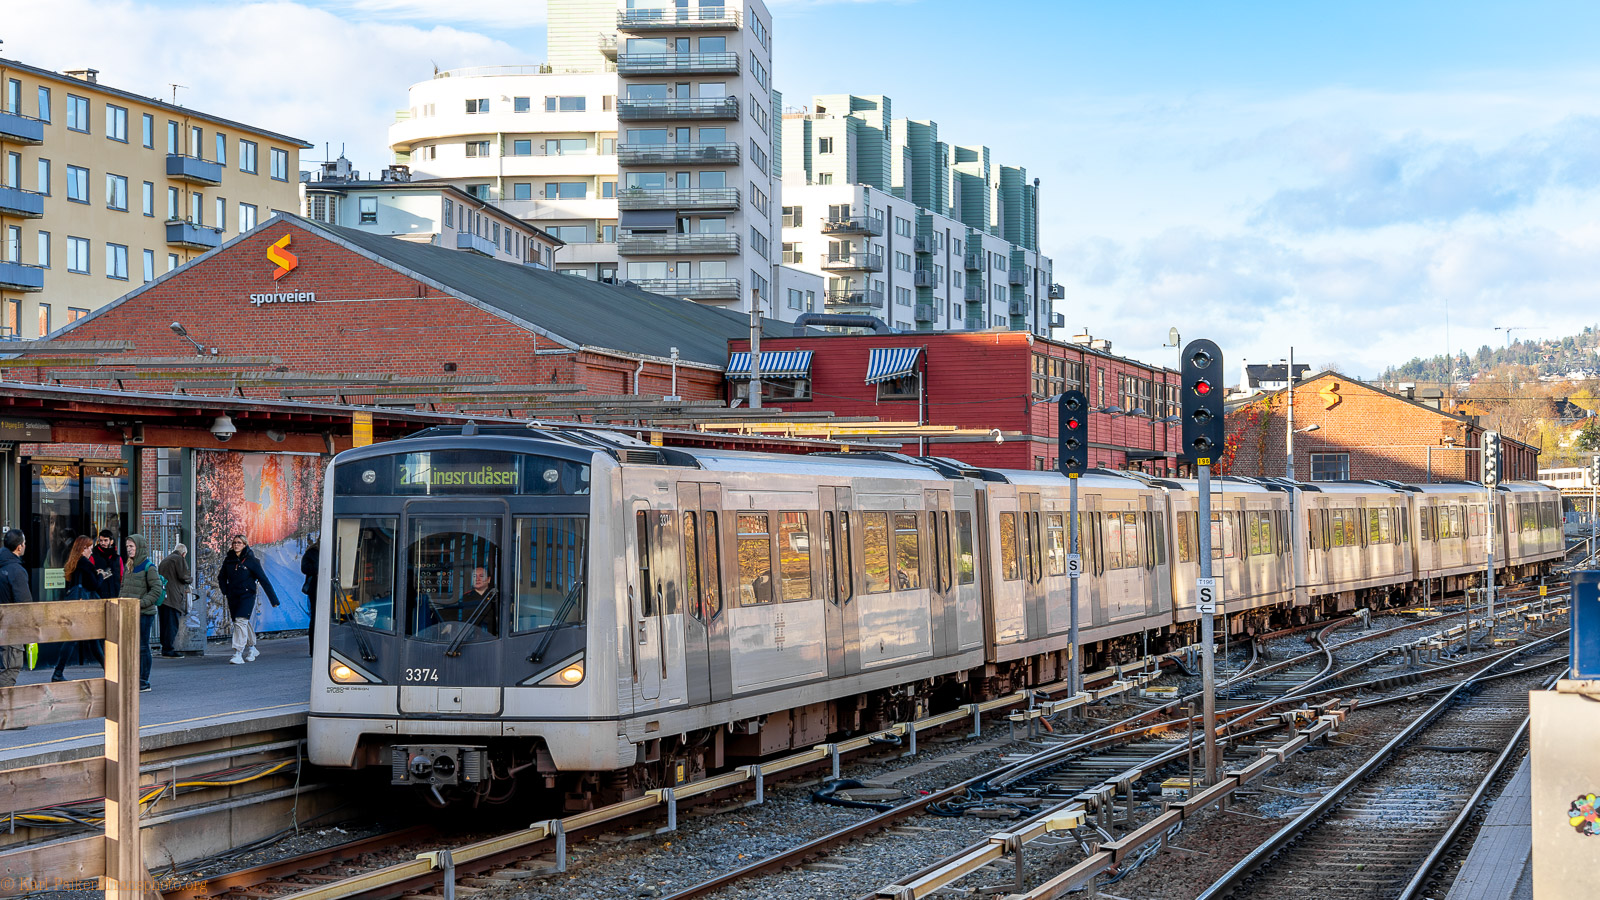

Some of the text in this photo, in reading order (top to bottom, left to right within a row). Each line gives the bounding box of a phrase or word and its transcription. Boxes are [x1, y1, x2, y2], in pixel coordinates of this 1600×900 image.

[249, 289, 316, 307] sporveien
[1069, 560, 1078, 571] S
[1200, 587, 1212, 603] S
[405, 668, 439, 682] 3374
